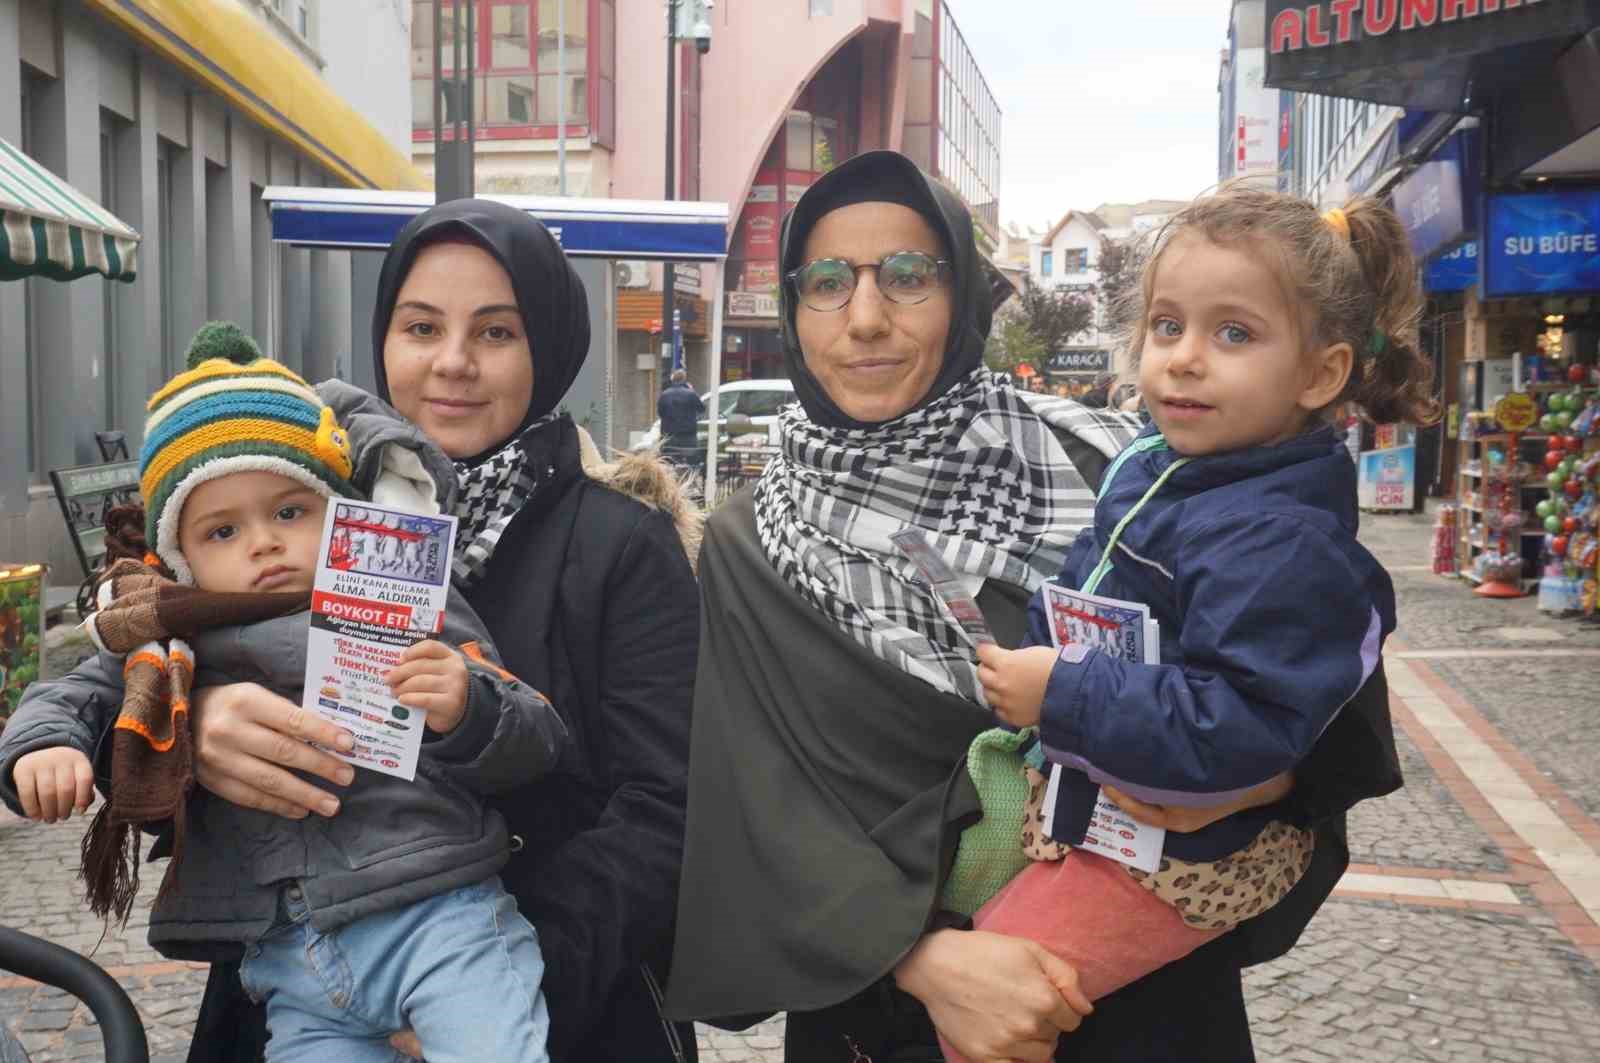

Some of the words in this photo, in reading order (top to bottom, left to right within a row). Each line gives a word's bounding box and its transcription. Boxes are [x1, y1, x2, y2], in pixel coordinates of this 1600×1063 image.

[1505, 237, 1533, 255] SU
[1057, 354, 1103, 366] KARACA
[333, 583, 366, 597] ALMA
[377, 591, 430, 608] ALDIRMA
[322, 600, 384, 622] BOYKOT
[387, 612, 409, 627] ET!
